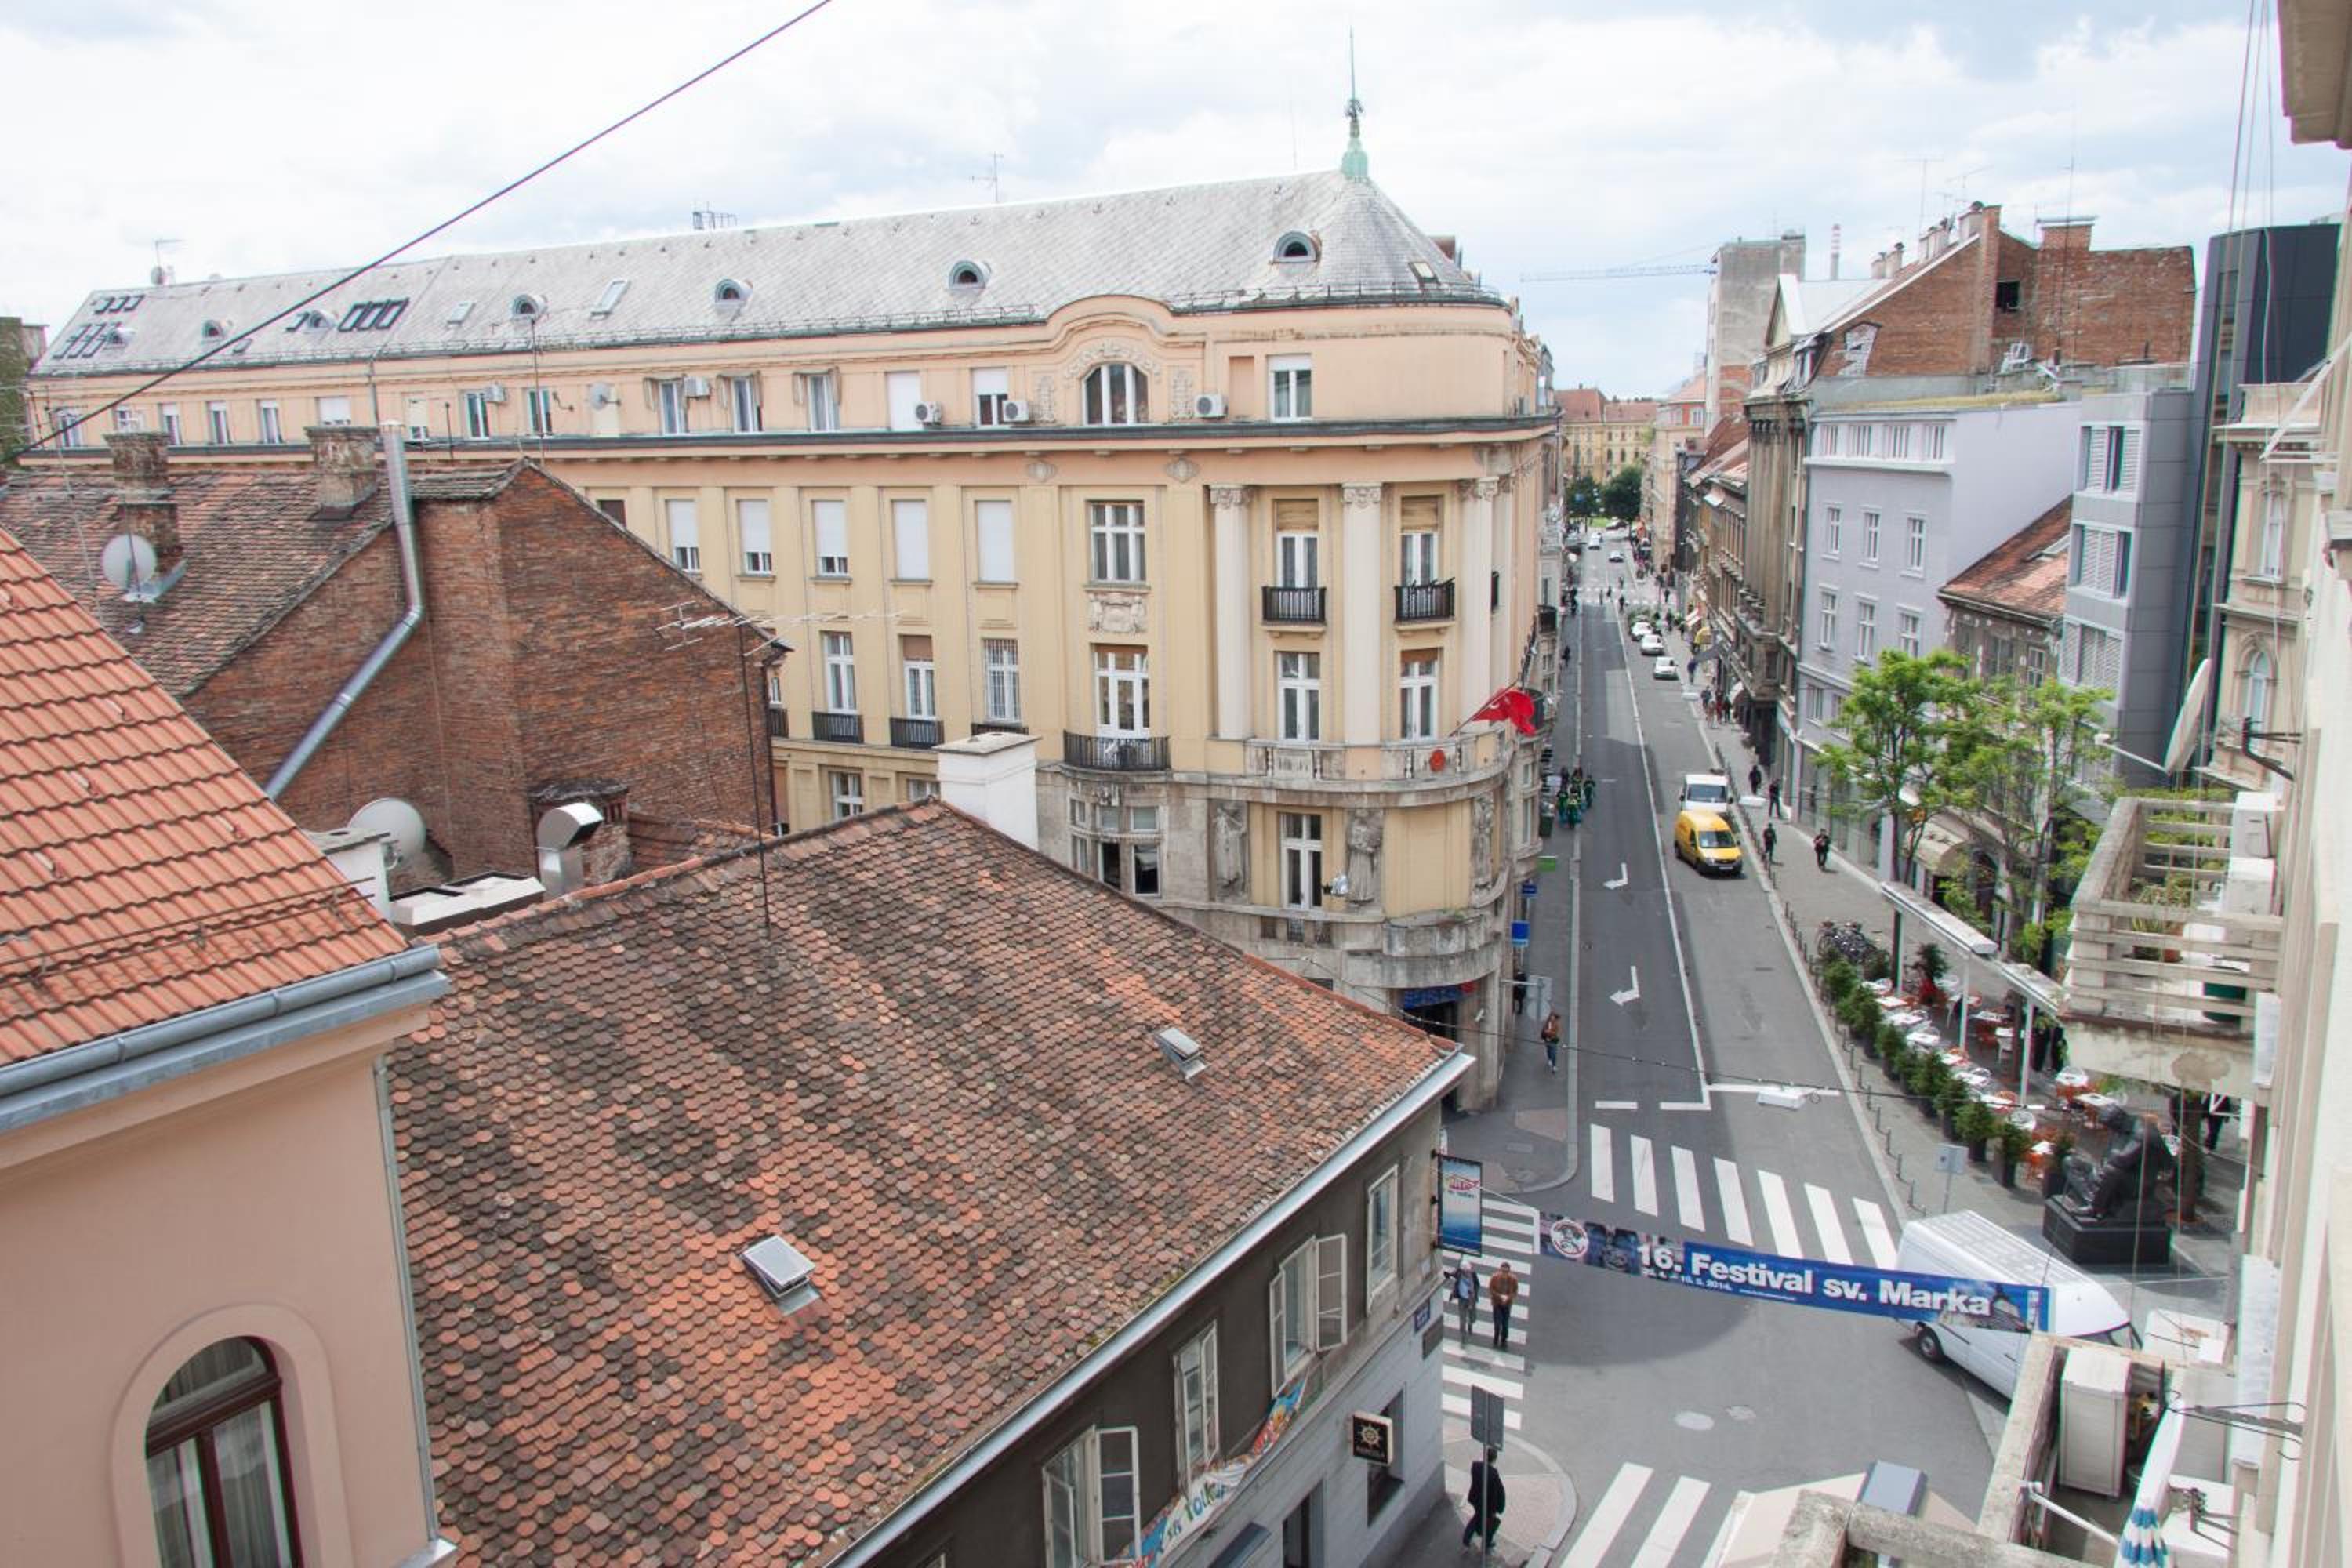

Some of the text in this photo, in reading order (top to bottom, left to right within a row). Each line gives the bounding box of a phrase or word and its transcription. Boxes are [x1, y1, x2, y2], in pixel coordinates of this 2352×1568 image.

[1637, 1244, 1682, 1272] 16.
[1690, 1252, 1813, 1294] Festival
[1823, 1278, 1867, 1301] sv.
[1878, 1279, 1991, 1316] Marka
